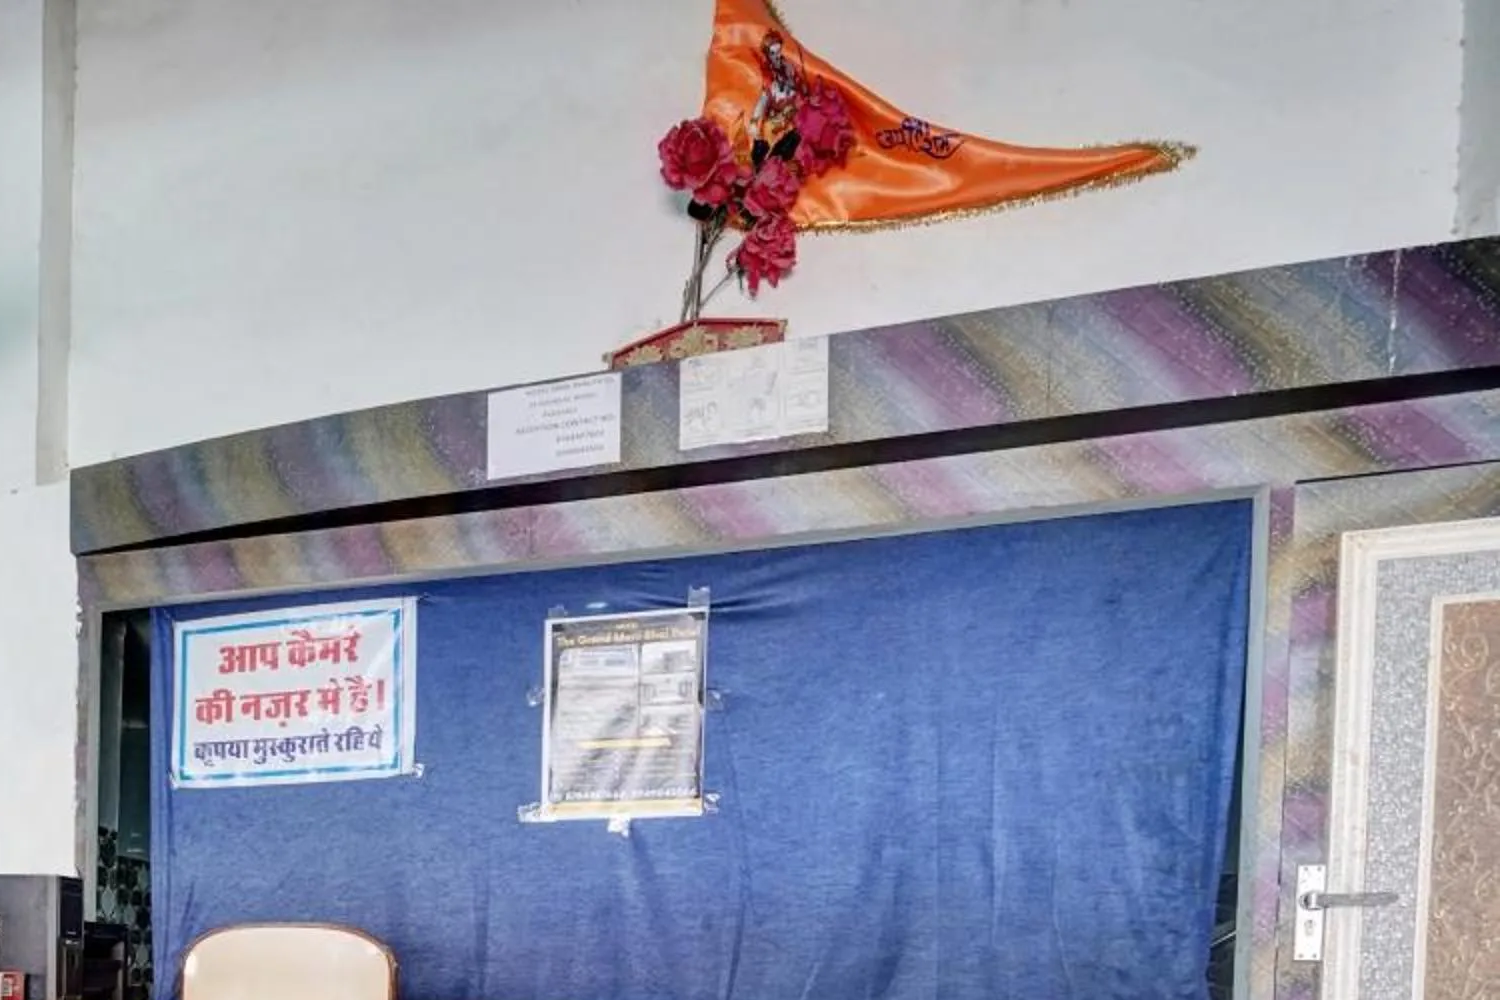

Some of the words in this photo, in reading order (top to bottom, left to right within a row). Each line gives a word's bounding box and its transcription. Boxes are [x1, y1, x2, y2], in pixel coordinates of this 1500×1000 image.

[219, 642, 282, 674] आप
[195, 688, 236, 724] की
[239, 690, 311, 728] नज़र
